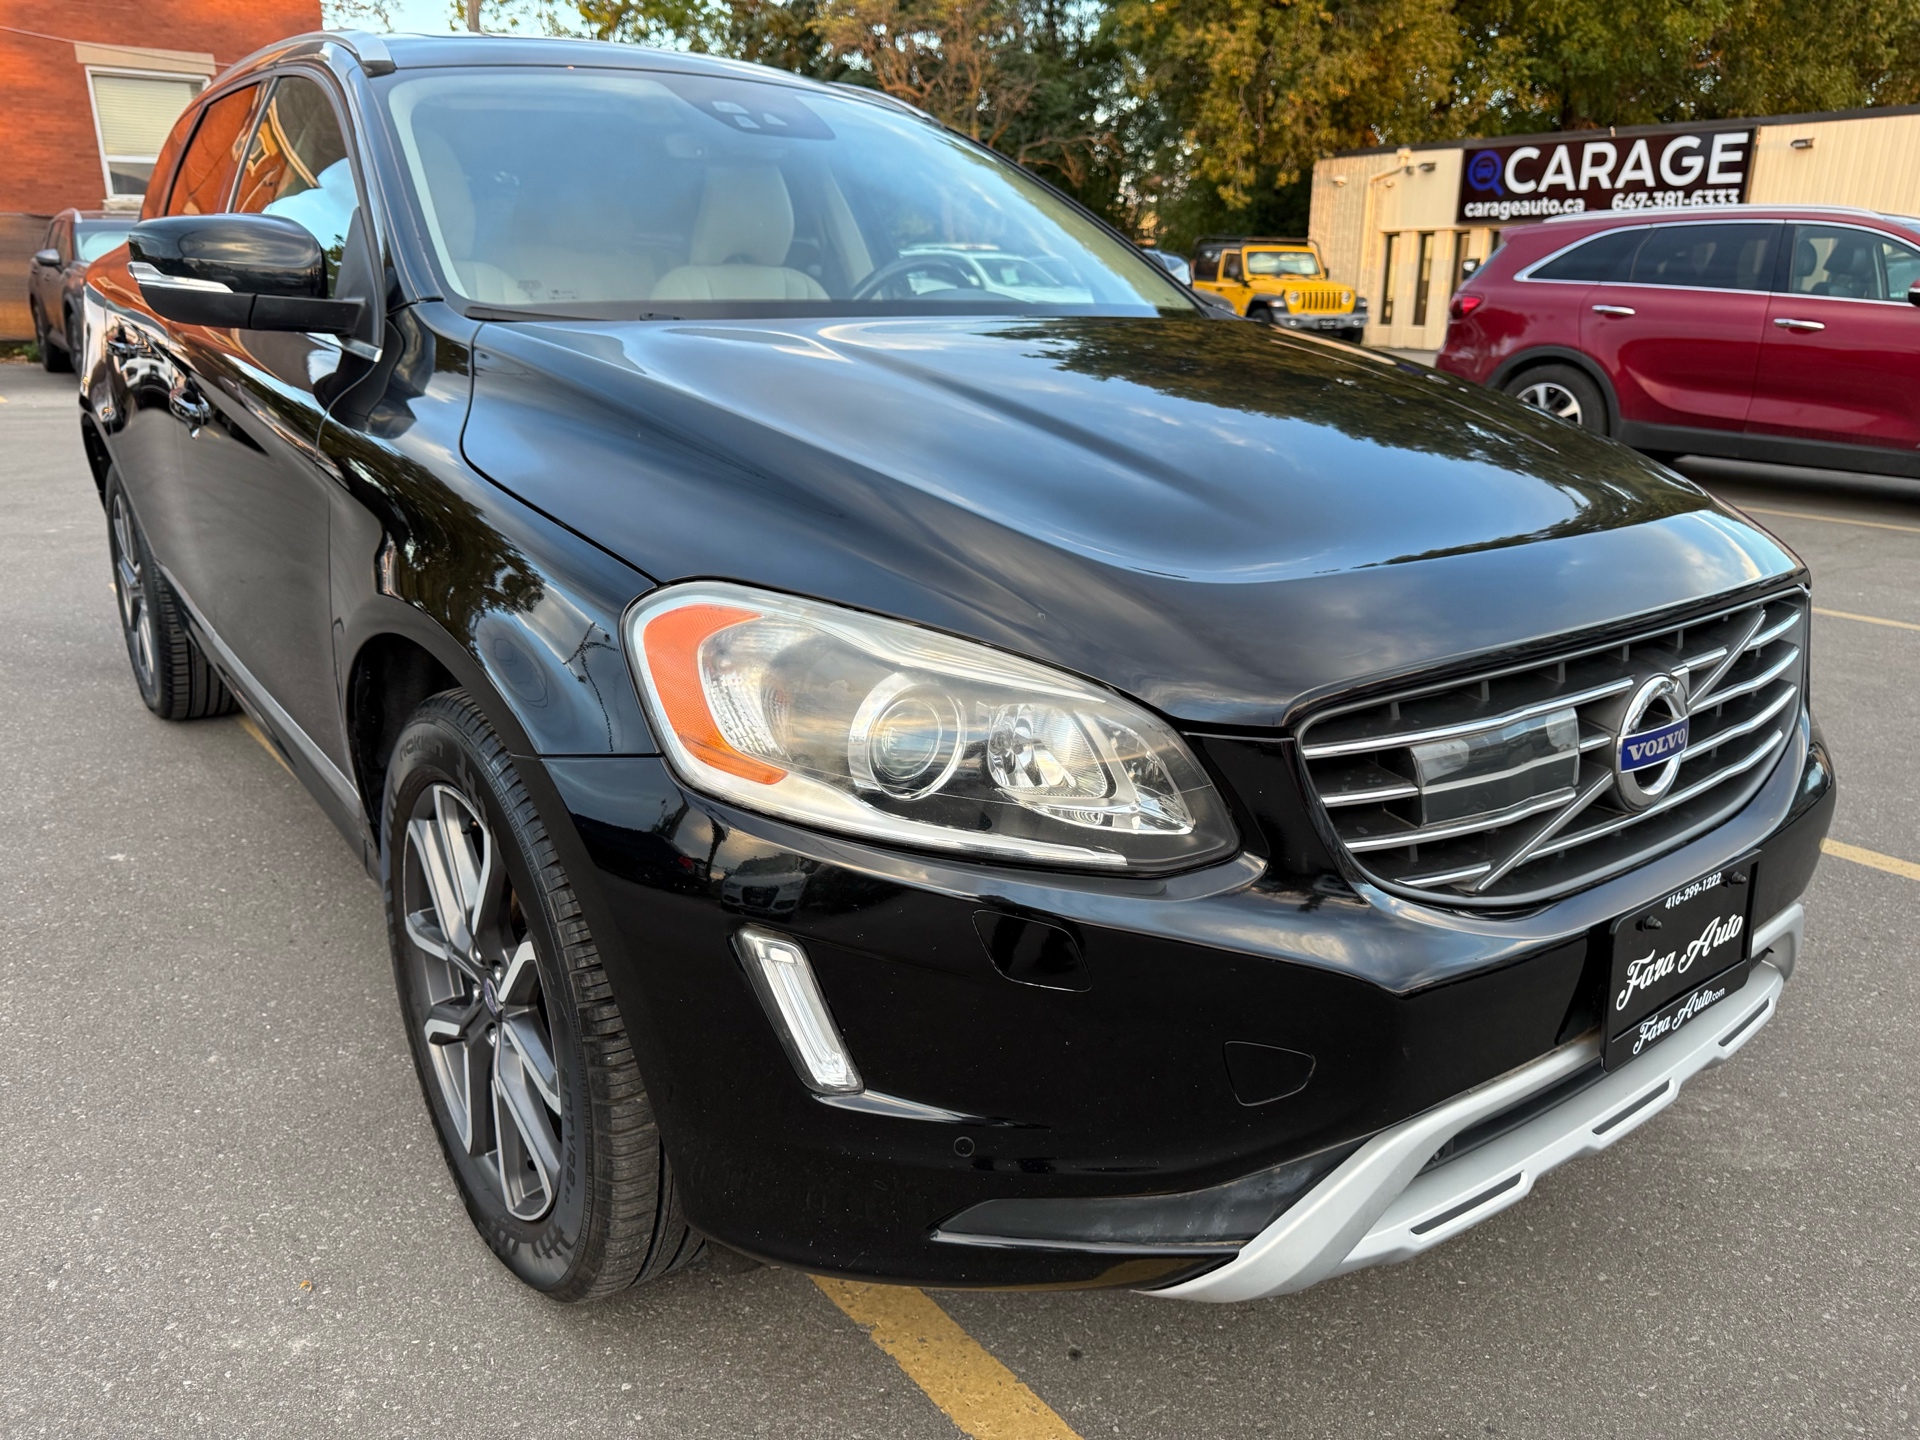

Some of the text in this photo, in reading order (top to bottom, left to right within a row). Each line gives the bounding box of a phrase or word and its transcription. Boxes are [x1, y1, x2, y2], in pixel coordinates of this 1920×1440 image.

[1504, 132, 1749, 194] CARAGE
[1464, 197, 1585, 220] carageauto.ca
[1611, 188, 1740, 211] 647-381-6333
[1627, 727, 1686, 761] VOLVO
[1665, 872, 1722, 910] 416-299-1222
[1615, 913, 1744, 1011] Fara Auto
[1632, 1014, 1671, 1055] Fara
